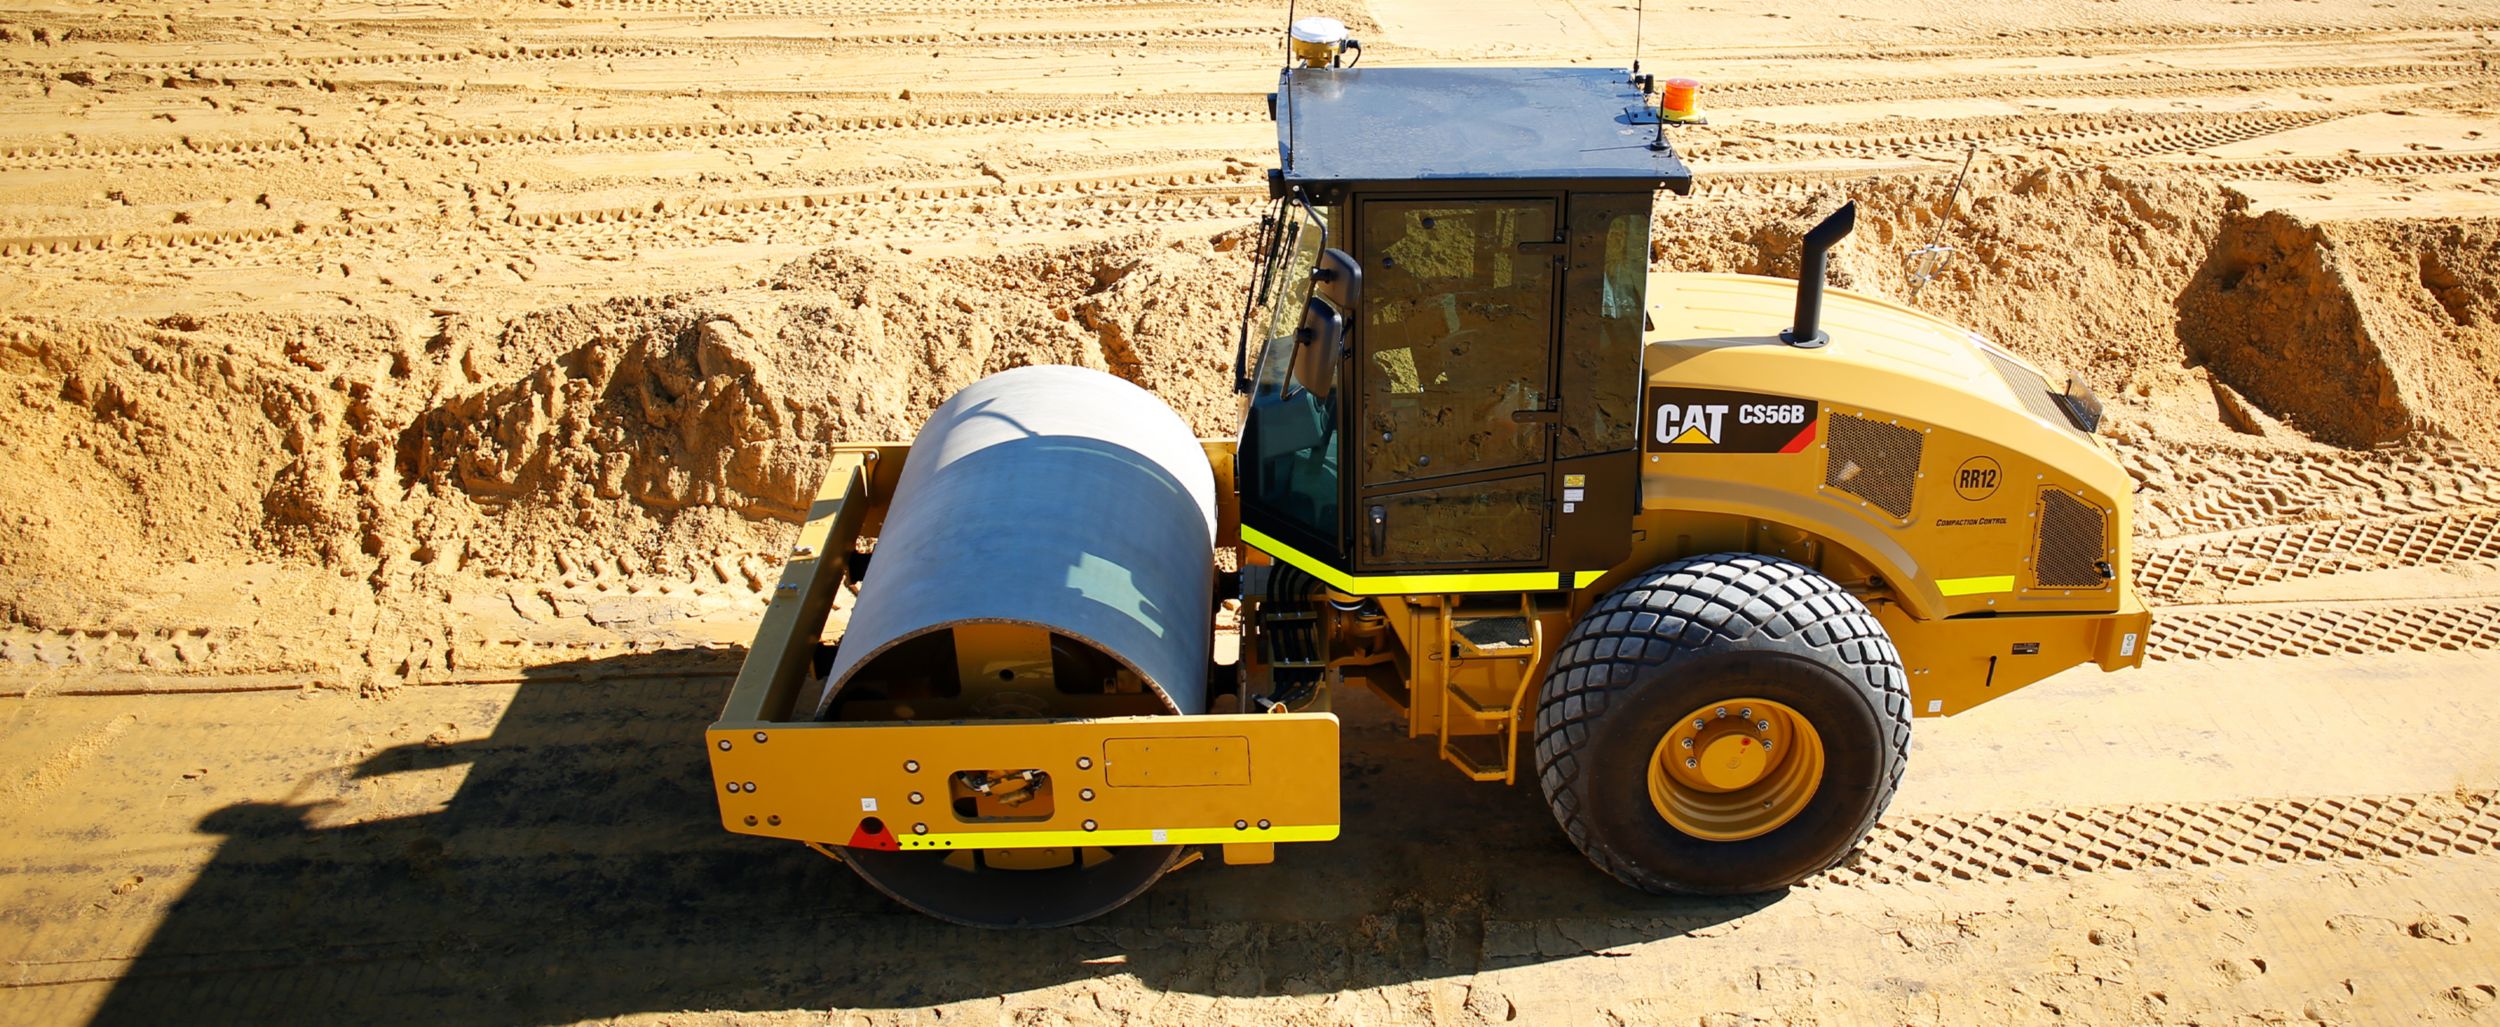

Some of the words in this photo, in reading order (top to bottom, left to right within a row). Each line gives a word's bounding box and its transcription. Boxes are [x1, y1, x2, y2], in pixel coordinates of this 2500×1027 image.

[1655, 404, 1729, 444] CAT
[1739, 405, 1805, 425] CS56B
[1960, 469, 1996, 489] RR12
